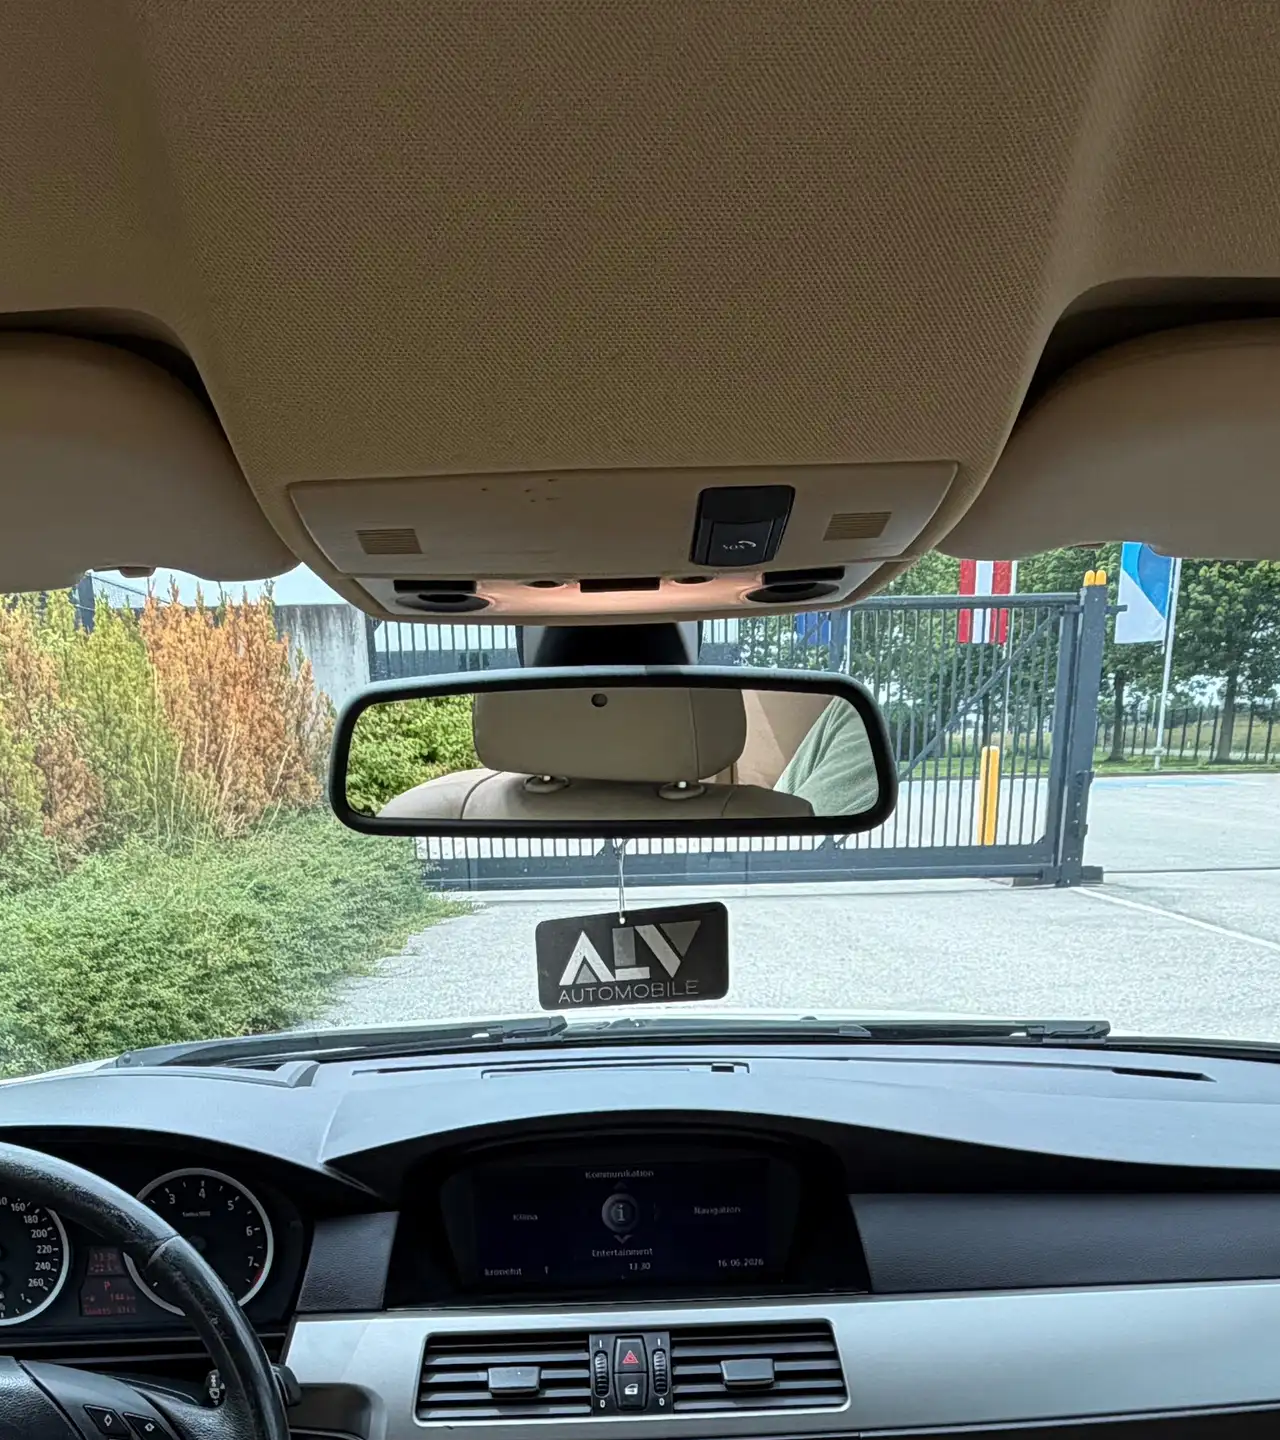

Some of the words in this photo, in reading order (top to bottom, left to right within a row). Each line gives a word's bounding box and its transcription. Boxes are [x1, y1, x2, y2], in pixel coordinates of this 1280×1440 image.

[558, 920, 702, 986] ALV
[558, 979, 700, 1004] AUTOMOBILE
[584, 1169, 655, 1179] Kommunikation
[198, 1187, 207, 1199] 4
[168, 1193, 176, 1205] 3
[10, 1202, 26, 1212] 160
[227, 1200, 235, 1211] 5
[23, 1214, 39, 1224] 180
[31, 1228, 48, 1238] 200
[245, 1225, 253, 1237] 6
[36, 1244, 53, 1254] 220
[591, 1246, 654, 1259] Entertainment
[35, 1261, 51, 1271] 240
[247, 1256, 254, 1267] 7
[28, 1278, 44, 1287] 260
